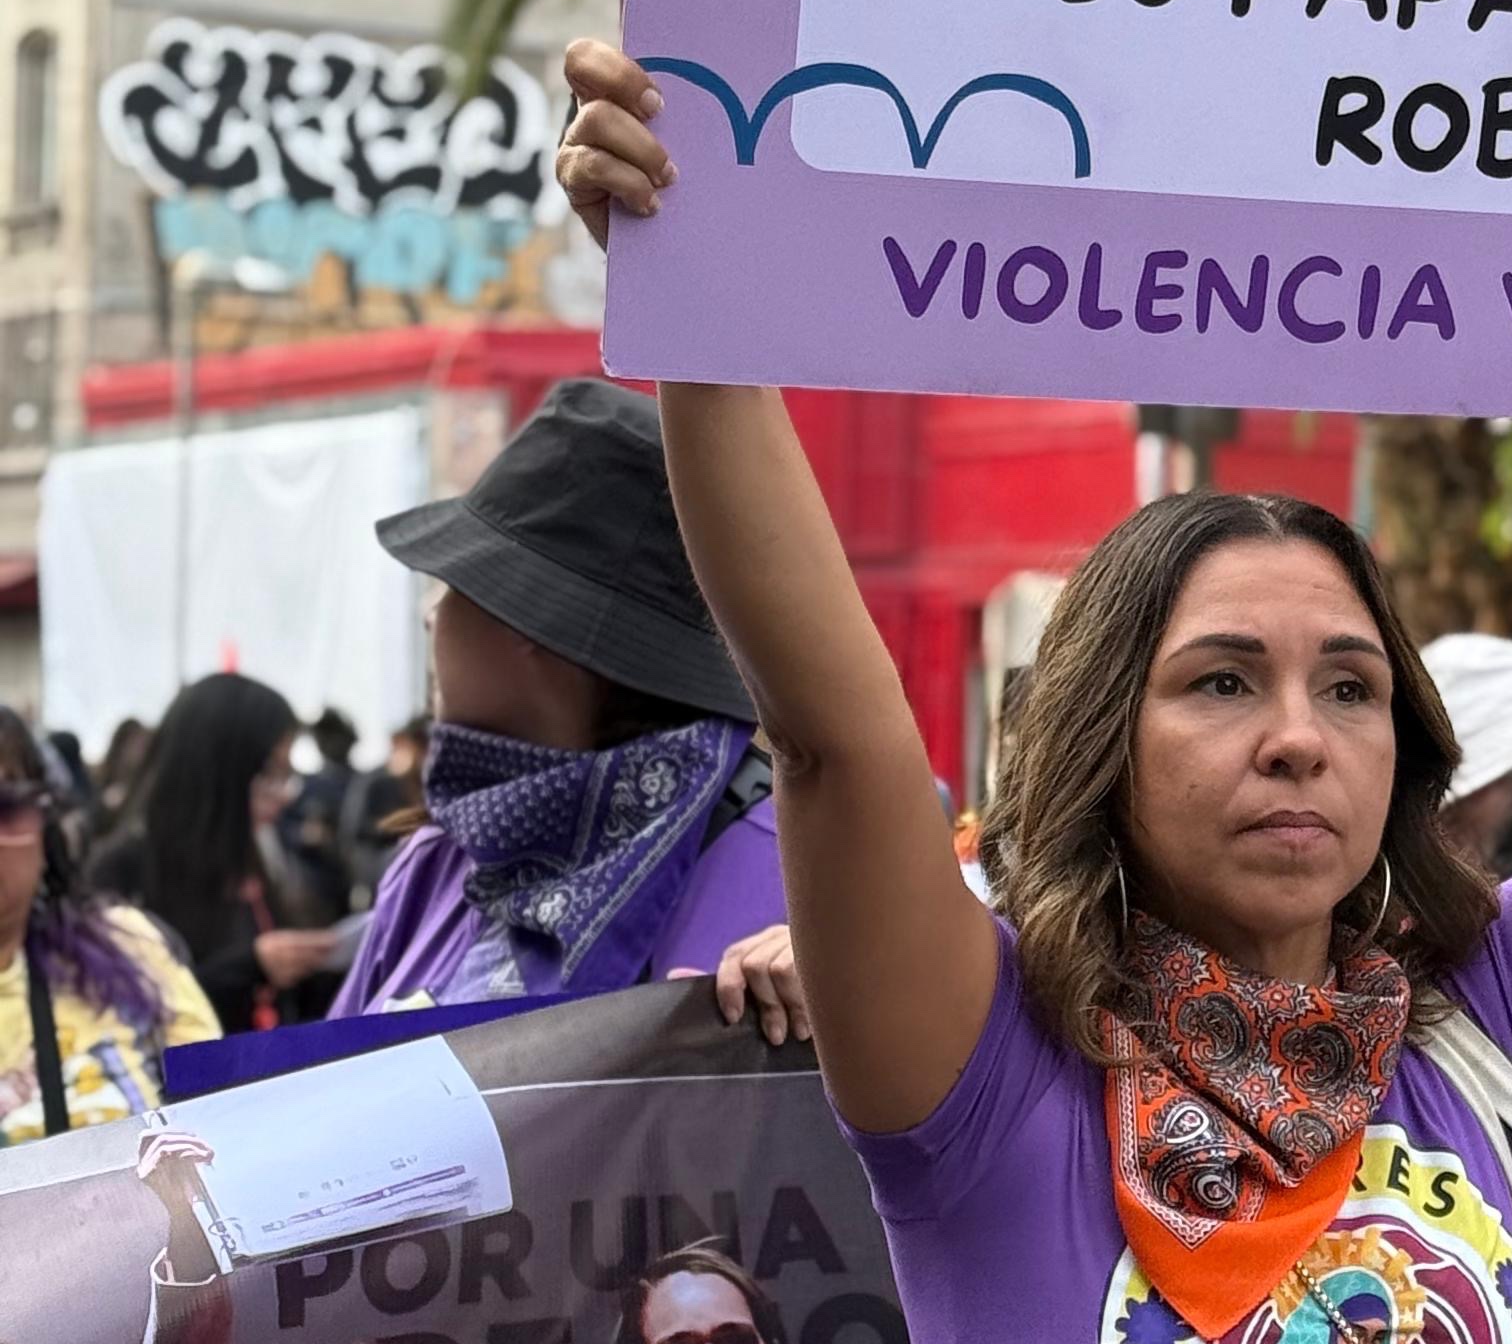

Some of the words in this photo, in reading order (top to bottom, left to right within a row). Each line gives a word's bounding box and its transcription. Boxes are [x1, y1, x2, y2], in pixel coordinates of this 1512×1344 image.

[882, 236, 1456, 344] VIOLENCIA
[275, 1208, 535, 1328] POR
[568, 1185, 847, 1283] UNA
